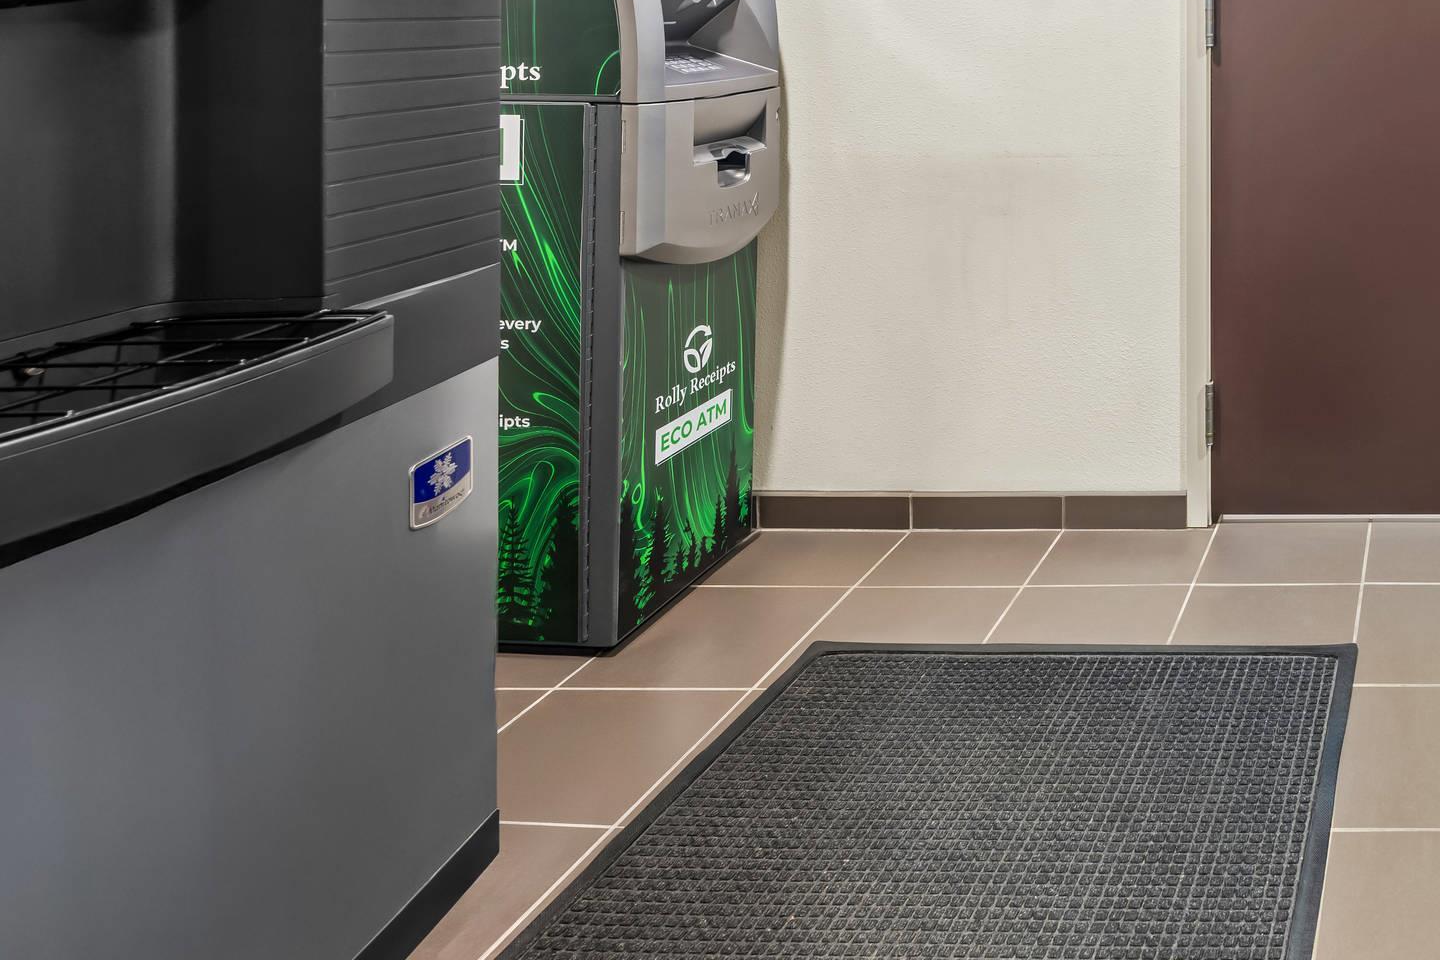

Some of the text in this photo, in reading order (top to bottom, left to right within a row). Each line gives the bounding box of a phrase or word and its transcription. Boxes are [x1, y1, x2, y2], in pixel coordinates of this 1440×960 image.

[655, 360, 736, 414] Rolly Receipts
[661, 398, 727, 452] ECO ATM
